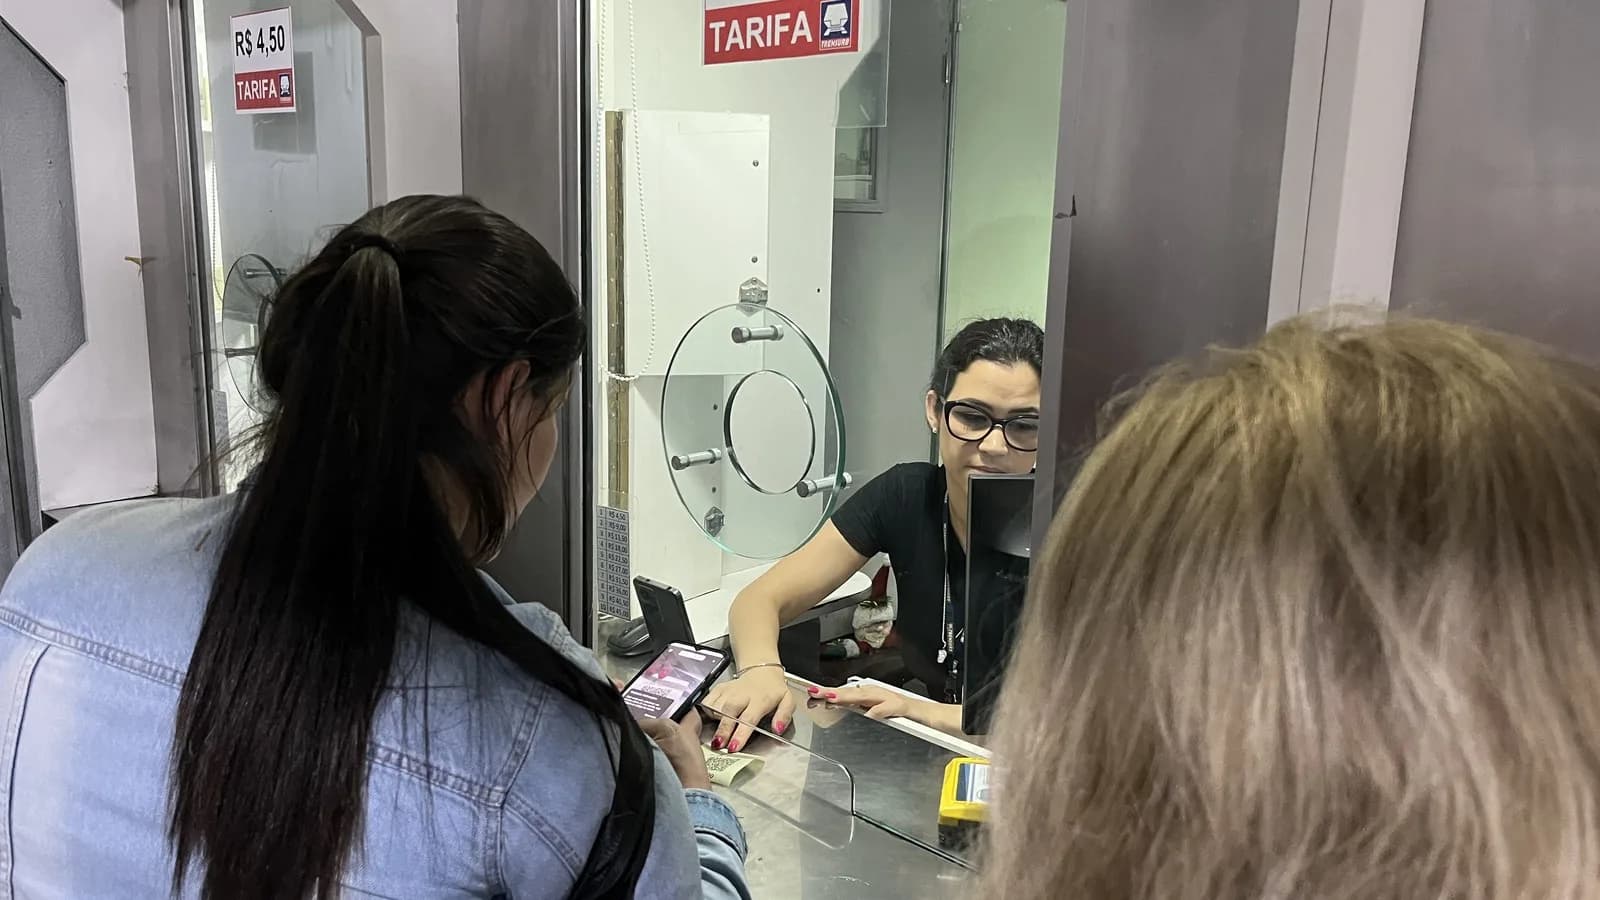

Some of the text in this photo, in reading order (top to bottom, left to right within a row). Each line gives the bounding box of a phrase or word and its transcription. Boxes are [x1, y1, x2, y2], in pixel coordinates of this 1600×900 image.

[235, 25, 285, 58] R$ 4,50
[709, 10, 813, 53] TARIFA
[236, 78, 278, 100] TARIFA
